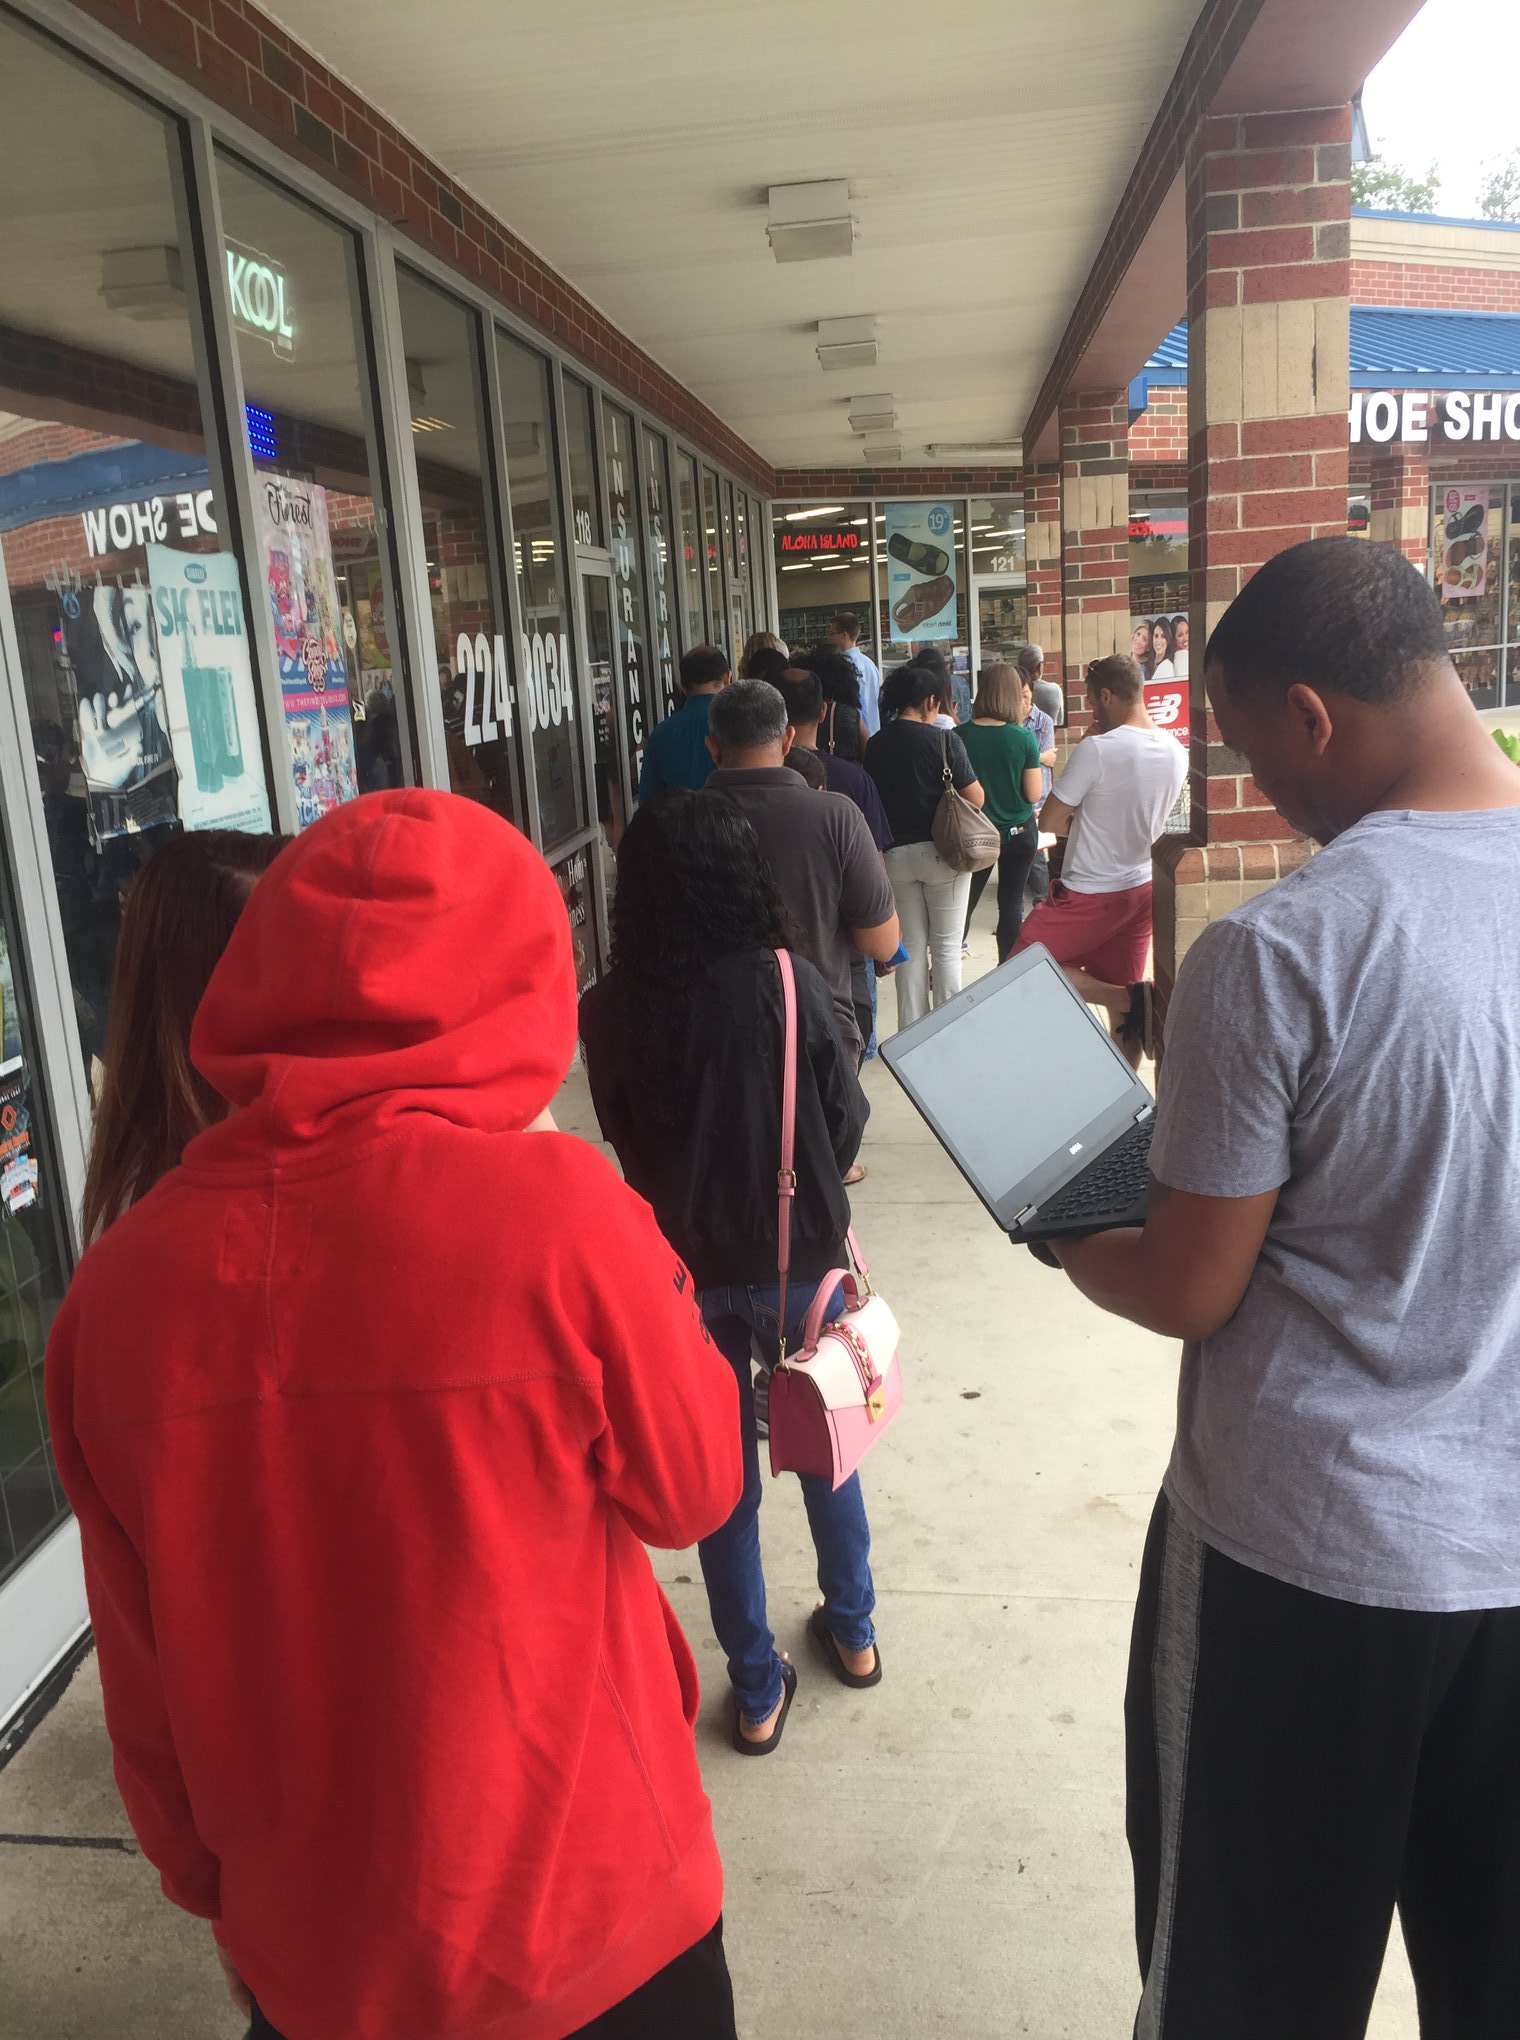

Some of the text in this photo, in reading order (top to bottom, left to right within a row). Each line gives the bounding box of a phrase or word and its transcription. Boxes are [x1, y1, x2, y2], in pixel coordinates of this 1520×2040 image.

[225, 248, 293, 338] KOOL
[576, 509, 592, 545] 118
[782, 533, 858, 550] ALOHA ISLAND
[990, 556, 1014, 572] 121
